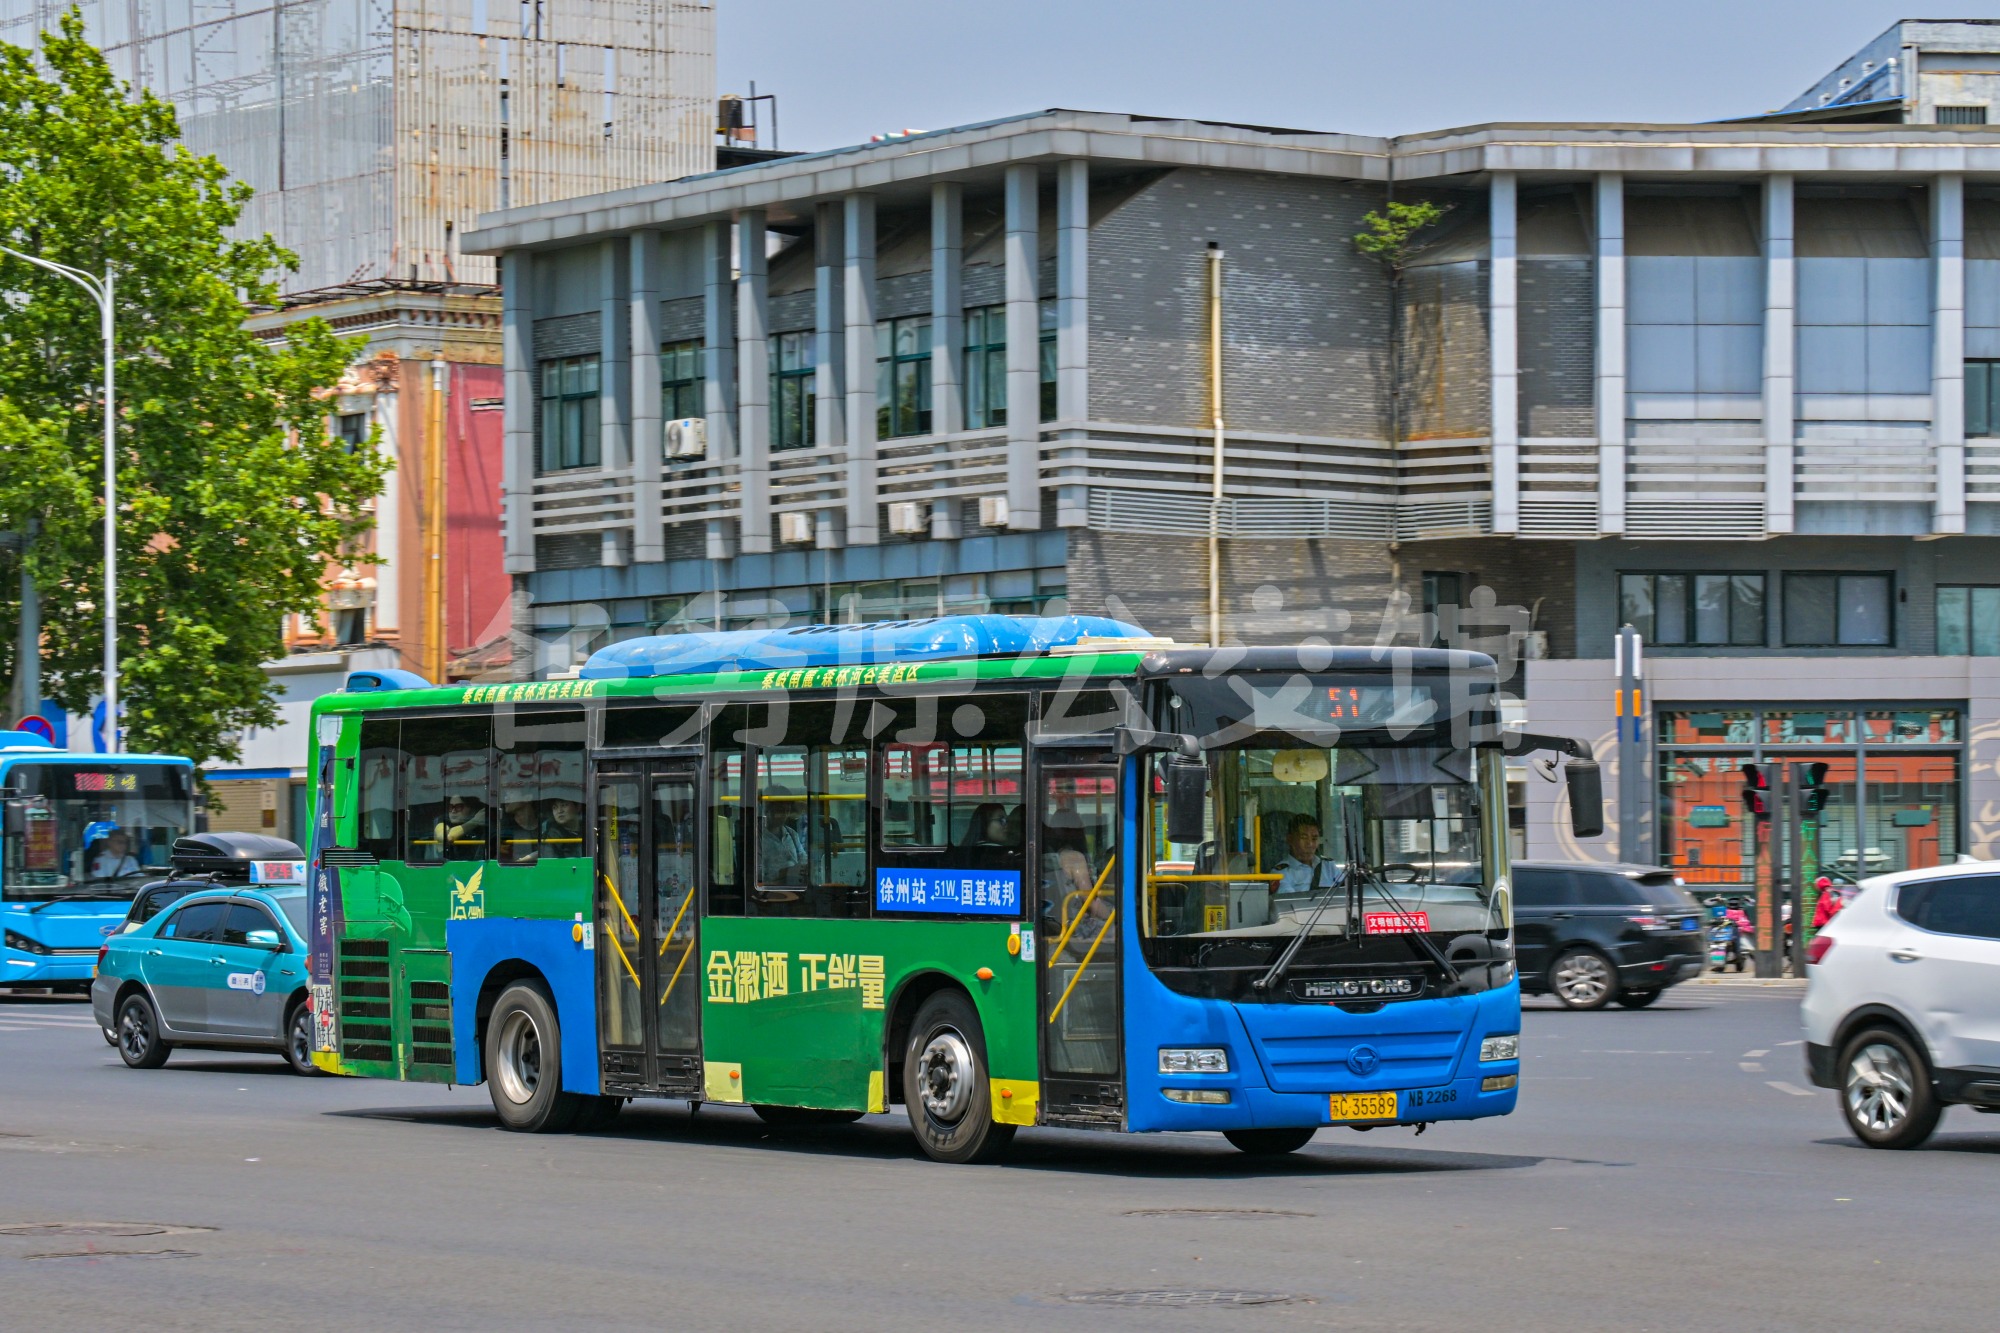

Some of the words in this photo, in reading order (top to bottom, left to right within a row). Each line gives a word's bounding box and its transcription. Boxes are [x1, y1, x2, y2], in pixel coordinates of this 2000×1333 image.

[1328, 687, 1359, 718] 51
[263, 862, 293, 880] 空车
[880, 877, 927, 905] 徐州站
[934, 879, 956, 898] 51W
[961, 879, 1015, 908] 国基城邦
[706, 950, 789, 1004] 金徽酒
[798, 953, 886, 1010] 正能量
[1305, 979, 1412, 997] HENGTONG
[1408, 1090, 1423, 1107] NB
[1426, 1089, 1457, 1104] 2268
